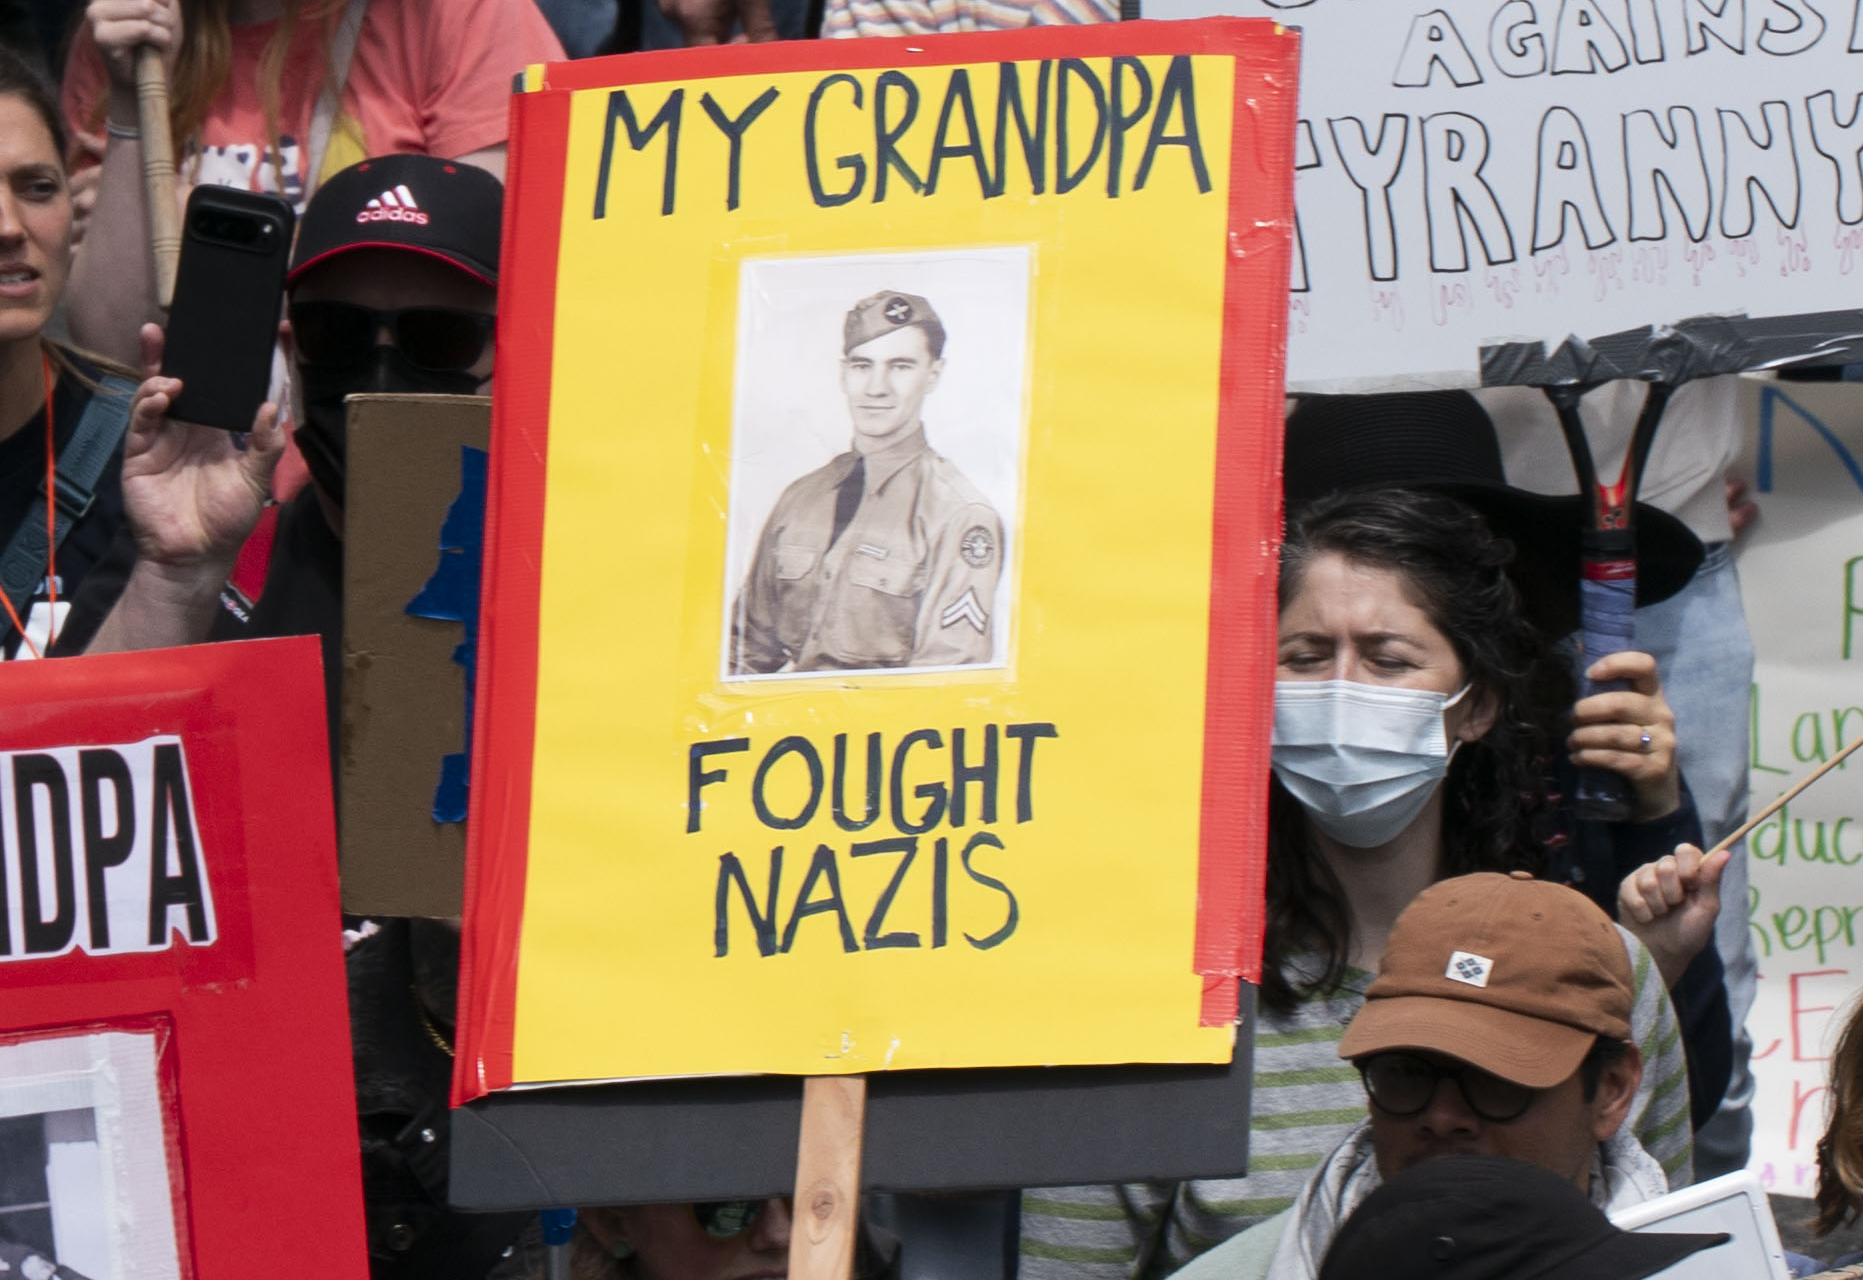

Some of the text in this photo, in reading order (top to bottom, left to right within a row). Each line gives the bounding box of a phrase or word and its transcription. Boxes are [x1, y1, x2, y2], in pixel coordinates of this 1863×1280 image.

[591, 55, 1213, 220] MY GRANDPA
[356, 205, 429, 226] adidas
[685, 721, 1059, 835] FOUGHT
[713, 830, 1020, 959] NAZIS
